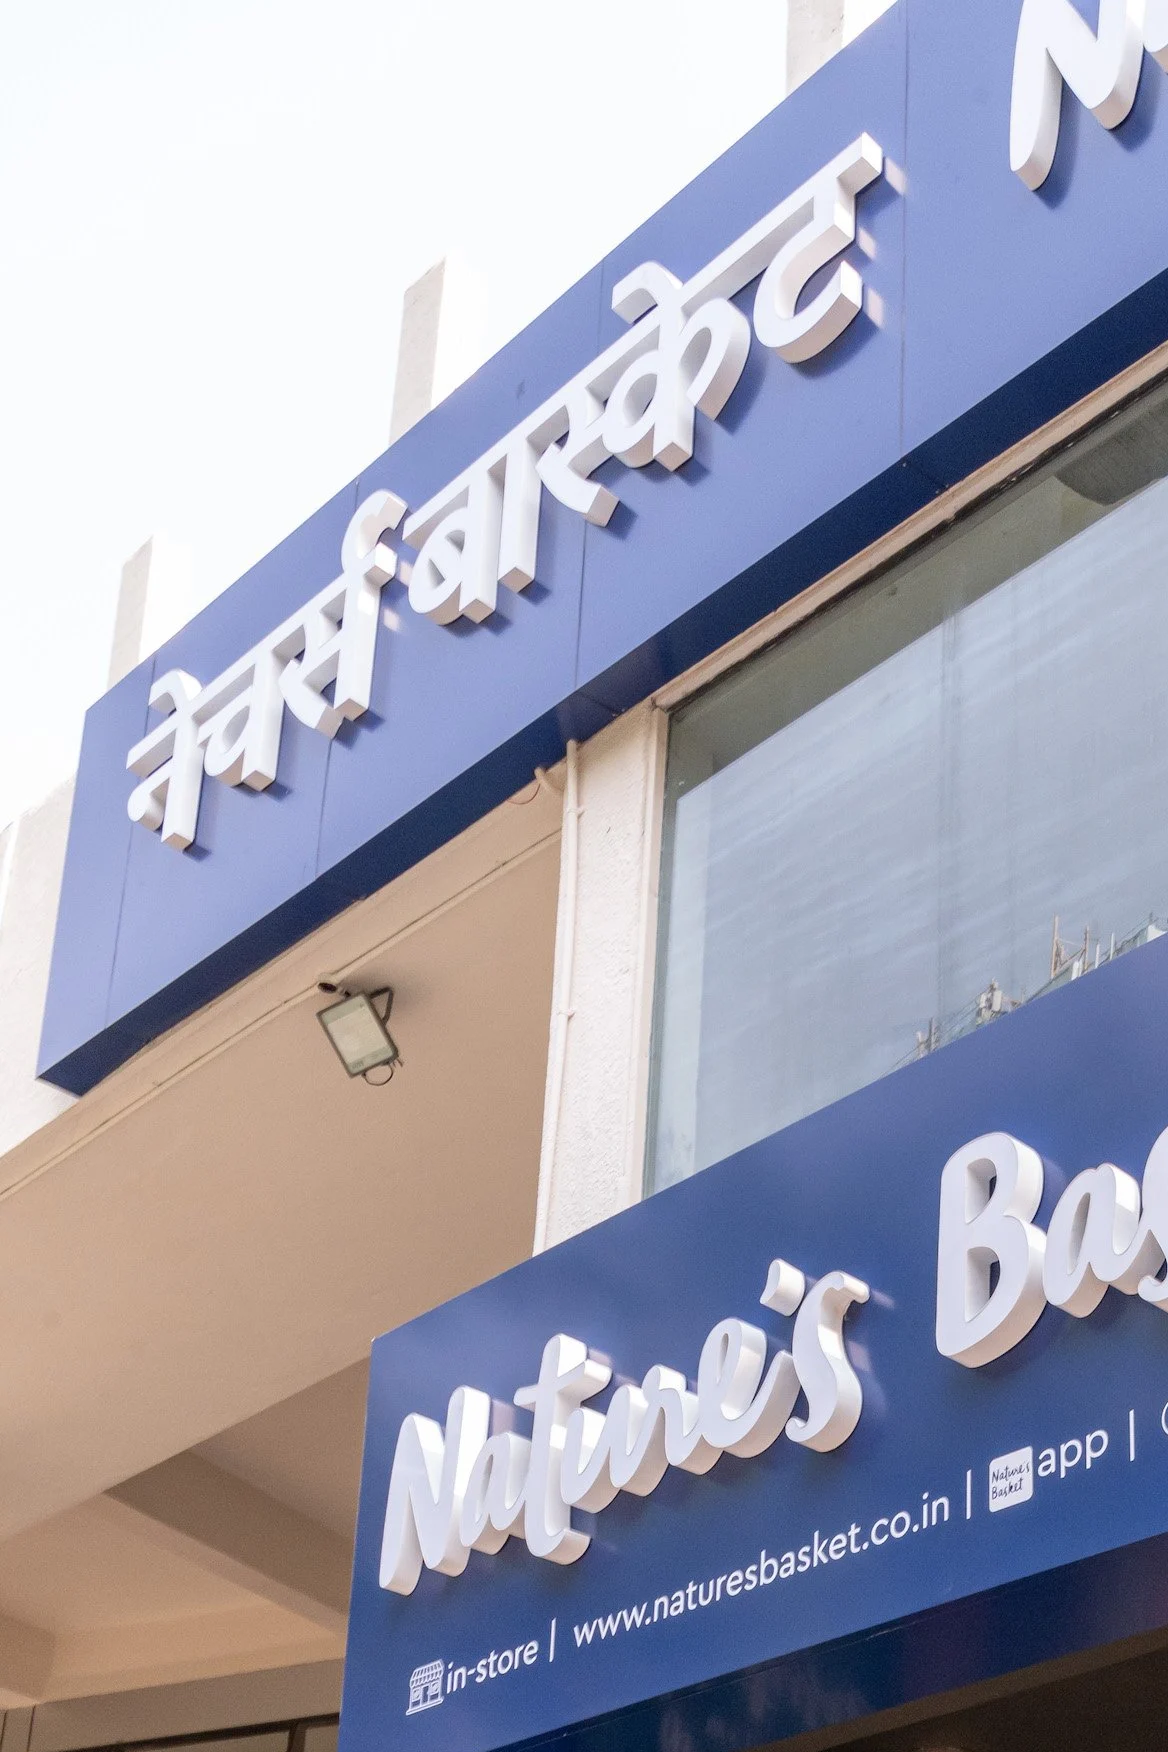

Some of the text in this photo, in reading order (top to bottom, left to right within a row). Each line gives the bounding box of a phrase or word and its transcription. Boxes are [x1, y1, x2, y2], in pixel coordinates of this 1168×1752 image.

[126, 131, 883, 851] नेचर्स बास्केट
[379, 1257, 871, 1596] Nature's
[446, 1633, 539, 1695] in-store
[572, 1490, 950, 1647] www.naturesbasket.co.in
[1036, 1424, 1110, 1479] app
[991, 1477, 1024, 1500] Basket
